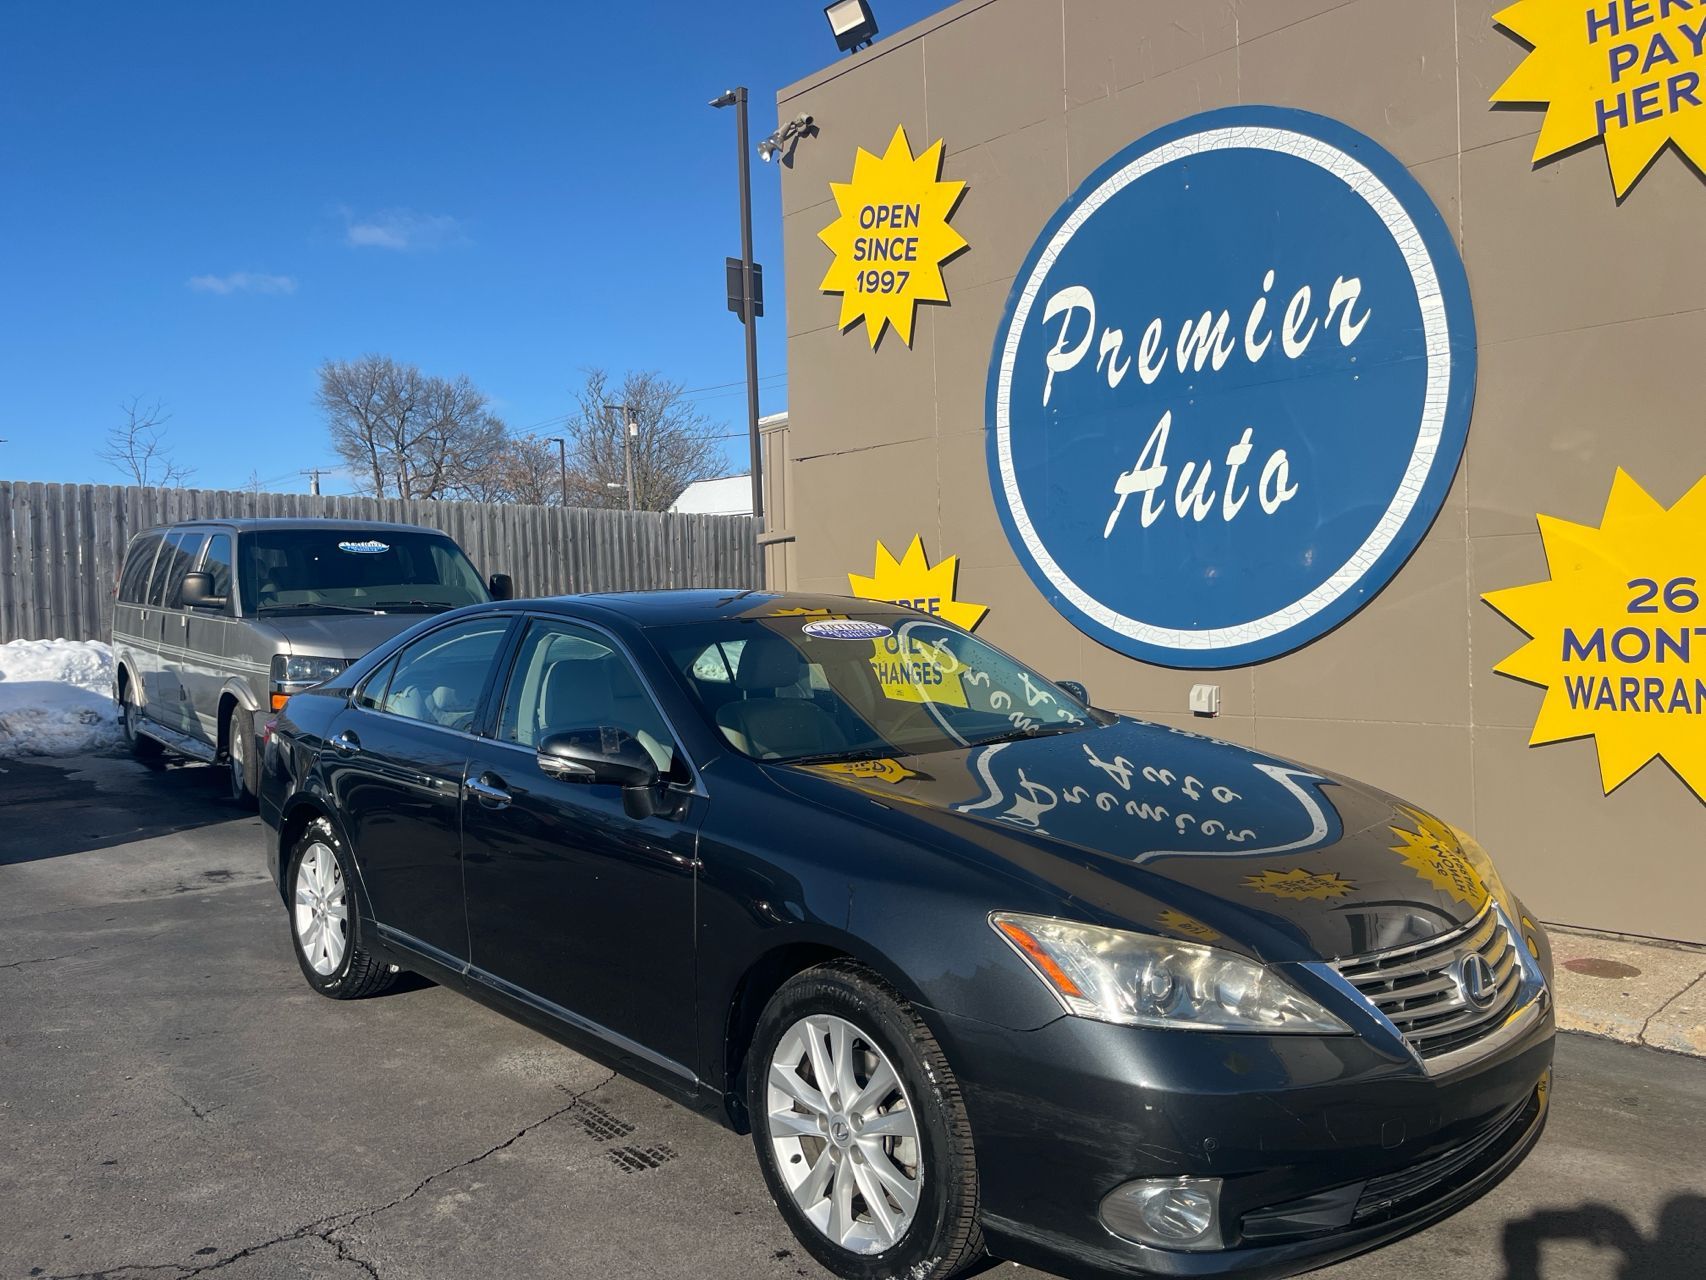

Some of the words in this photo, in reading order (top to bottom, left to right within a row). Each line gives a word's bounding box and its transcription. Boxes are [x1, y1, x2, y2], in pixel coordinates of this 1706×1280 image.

[1586, 0, 1706, 44] HE
[1608, 17, 1706, 84] PAY
[1594, 71, 1704, 135] HER
[859, 204, 921, 229] OPEN
[853, 237, 919, 261] SINCE
[856, 270, 910, 294] 1997
[1042, 269, 1371, 407] Premier
[1103, 410, 1299, 539] Auto
[1627, 577, 1699, 613] 26
[884, 635, 922, 654] OIL
[872, 661, 943, 685] HANGES
